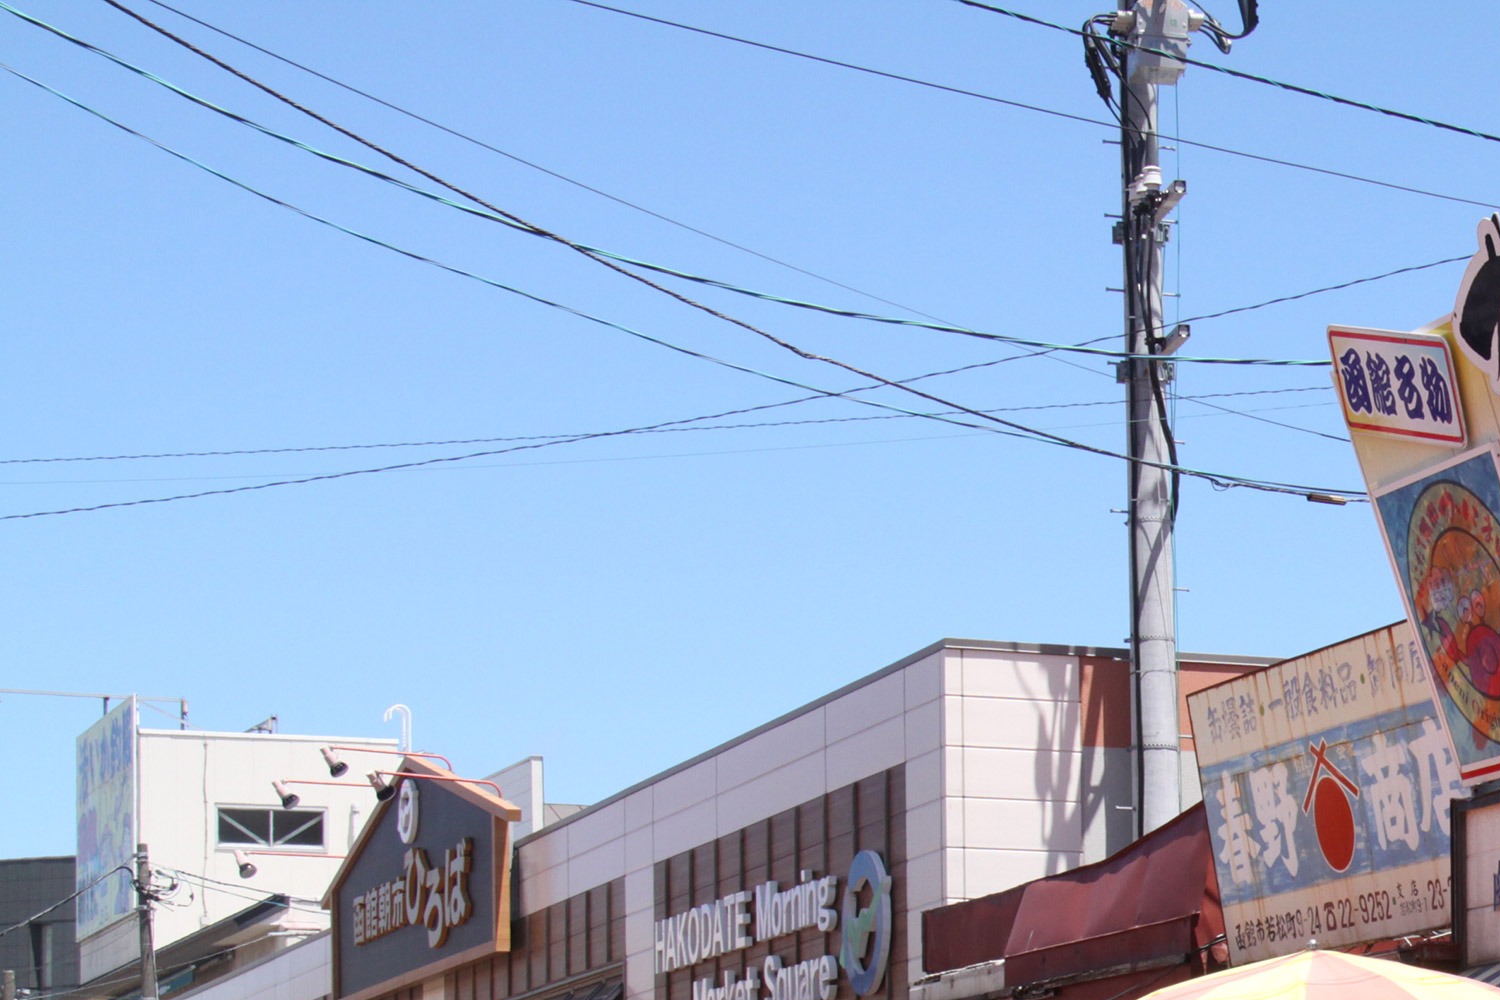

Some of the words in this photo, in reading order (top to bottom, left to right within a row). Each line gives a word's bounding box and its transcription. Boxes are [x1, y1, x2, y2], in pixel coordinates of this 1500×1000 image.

[1340, 347, 1452, 424] 函館名物
[1217, 762, 1299, 885] 春野
[1360, 715, 1471, 851] 商店
[352, 837, 474, 949] 函館朝市ひろば
[654, 889, 754, 975] HAKODATE
[755, 869, 838, 942] Morning
[1339, 890, 1393, 929] 22-9252
